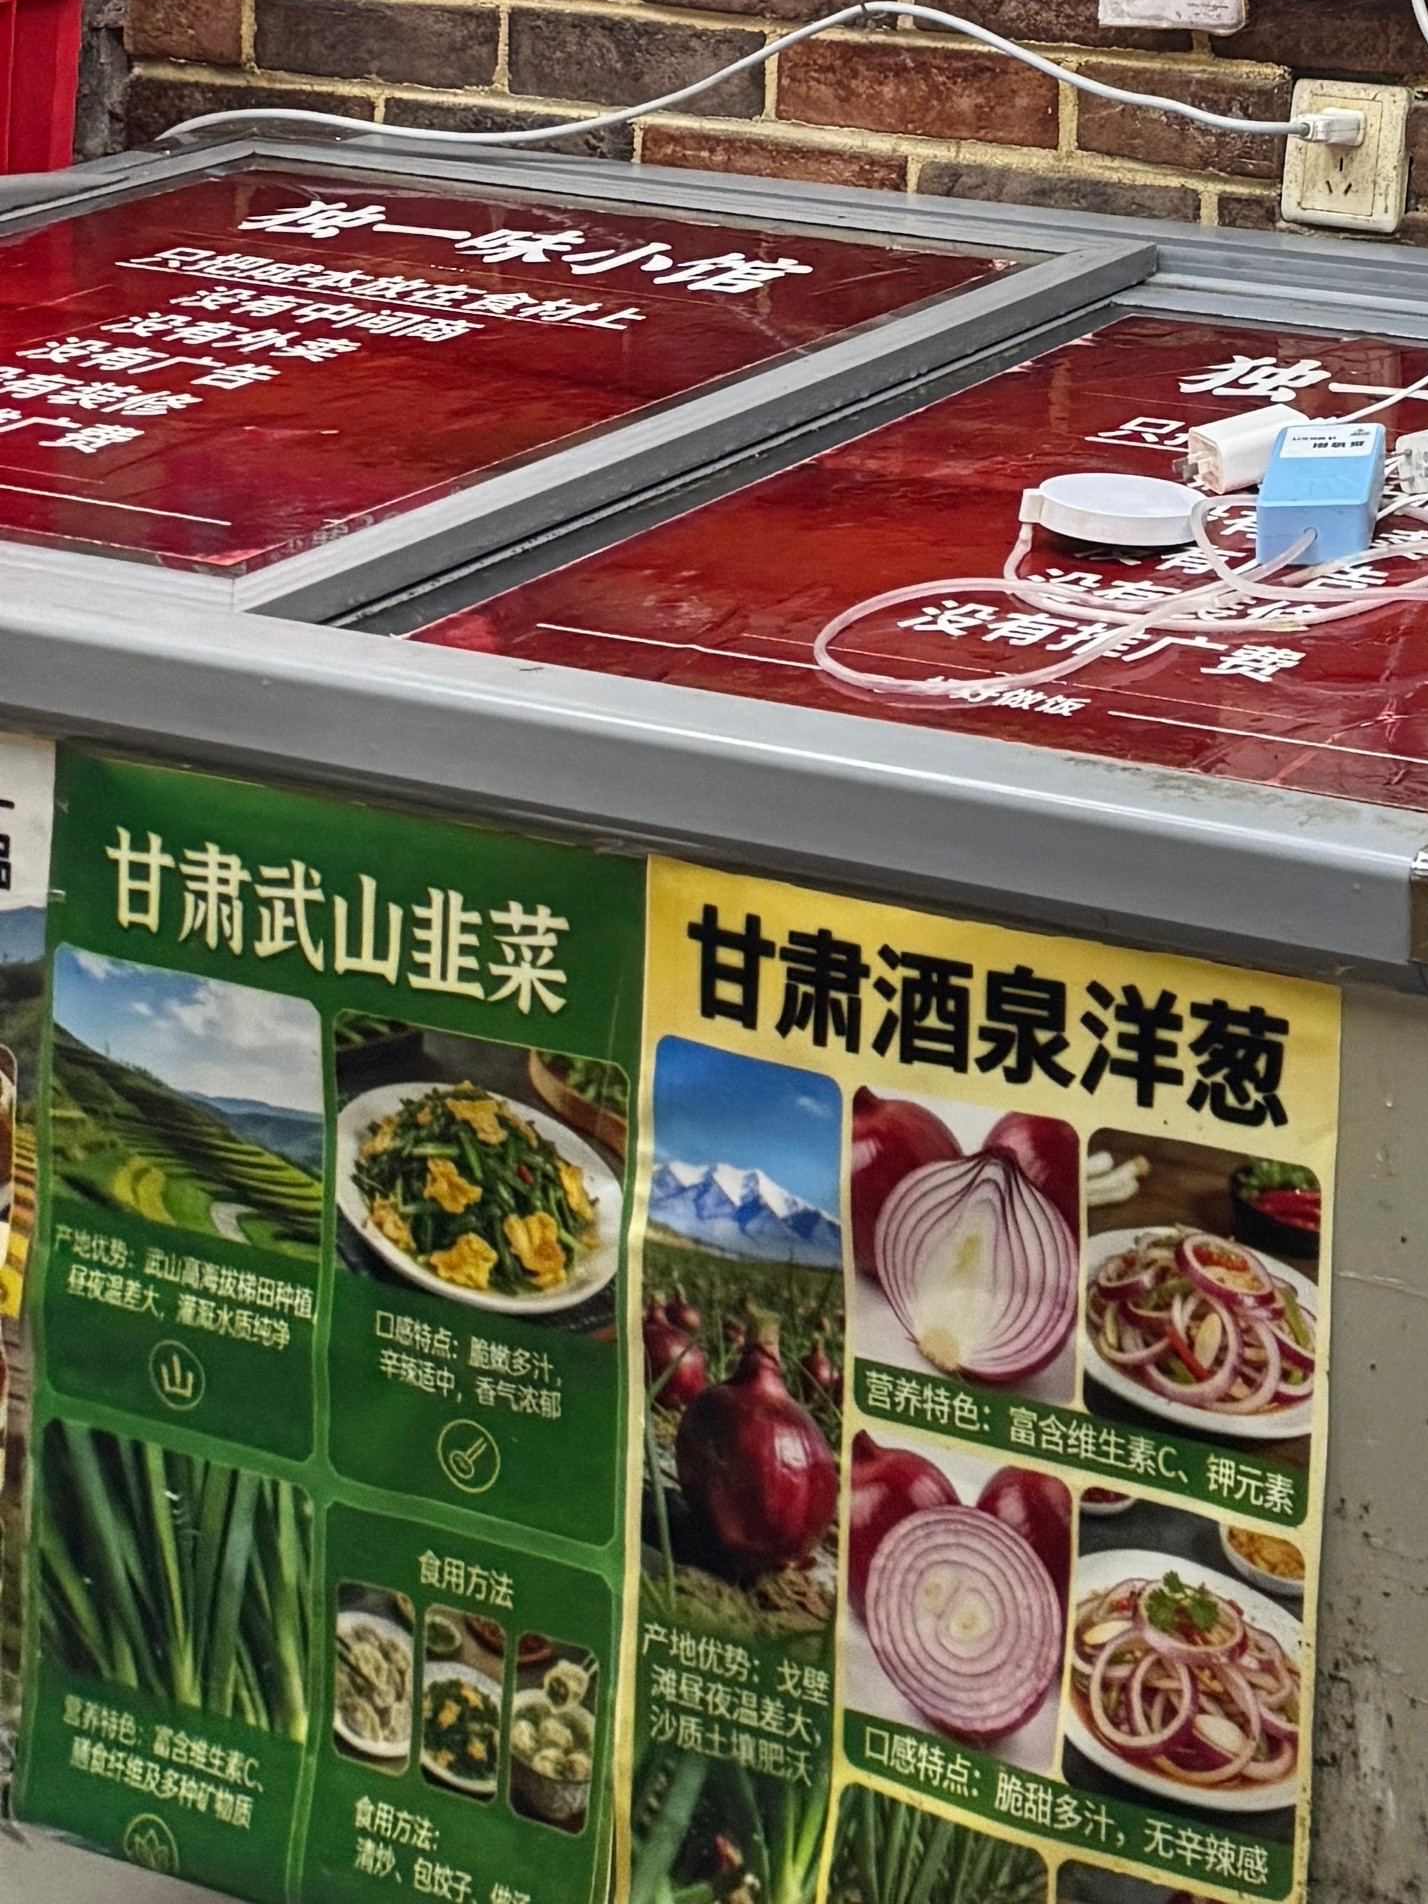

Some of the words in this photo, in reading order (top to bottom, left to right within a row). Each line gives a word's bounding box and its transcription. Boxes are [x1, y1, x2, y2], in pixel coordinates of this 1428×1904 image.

[238, 200, 815, 296] 独一味小馆
[131, 246, 647, 330] 只把成本放在食材上
[170, 285, 485, 343] 没有中间商
[17, 336, 281, 390] 没有广告
[101, 310, 362, 363] 没有外卖
[106, 824, 570, 1015] 甘肃武山韭菜
[687, 903, 1290, 1128] 甘肃酒泉洋葱
[417, 1549, 515, 1610] 食用方法
